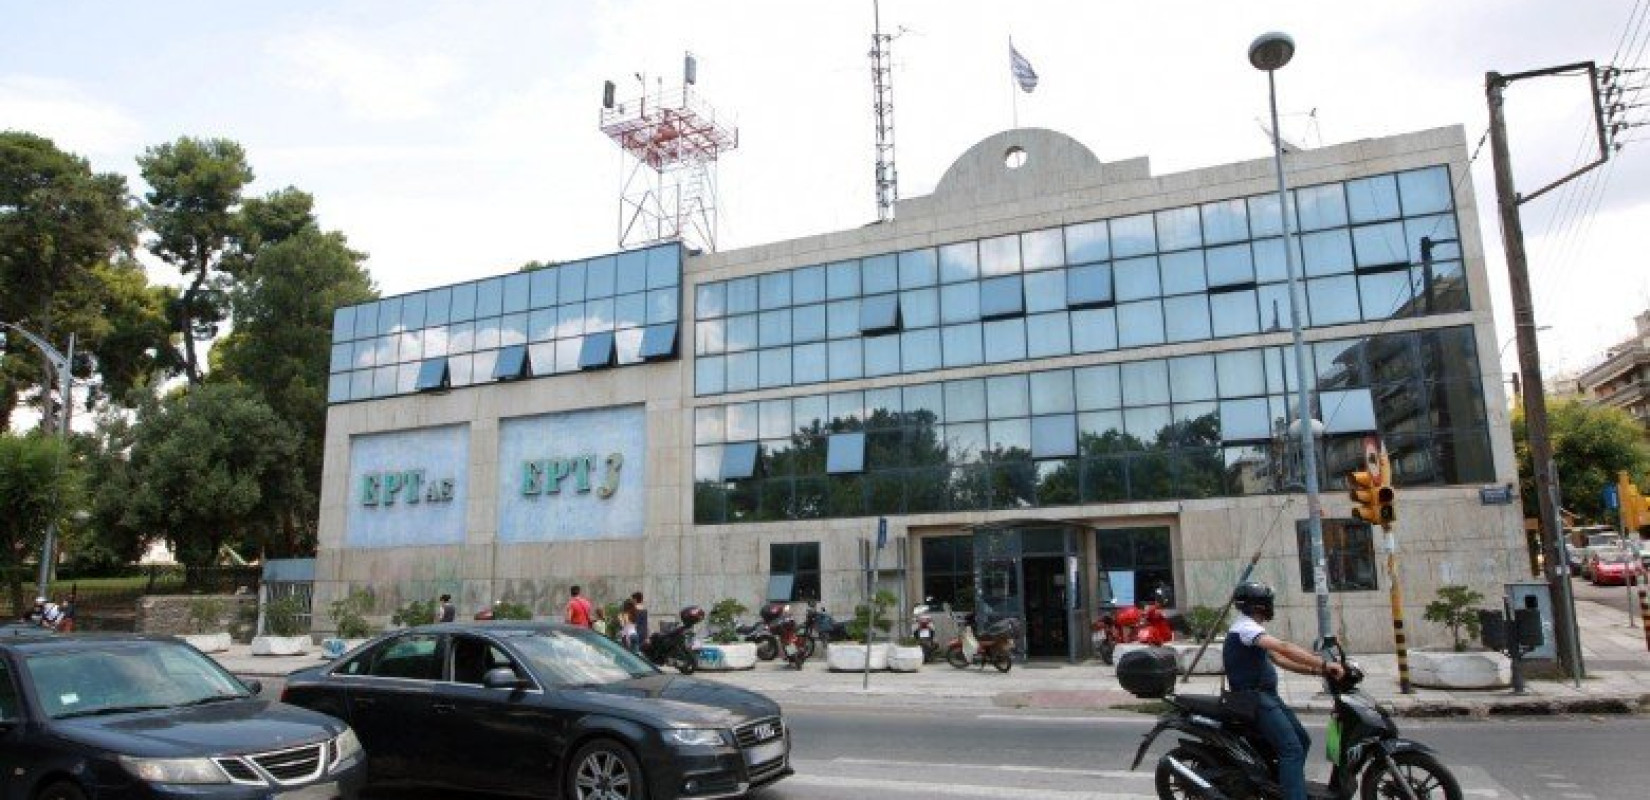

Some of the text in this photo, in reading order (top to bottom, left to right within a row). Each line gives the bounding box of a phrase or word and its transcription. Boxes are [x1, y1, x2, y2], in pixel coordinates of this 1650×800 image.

[361, 468, 425, 506] ΕΡΤ
[520, 452, 624, 500] ΕΡΤ 3
